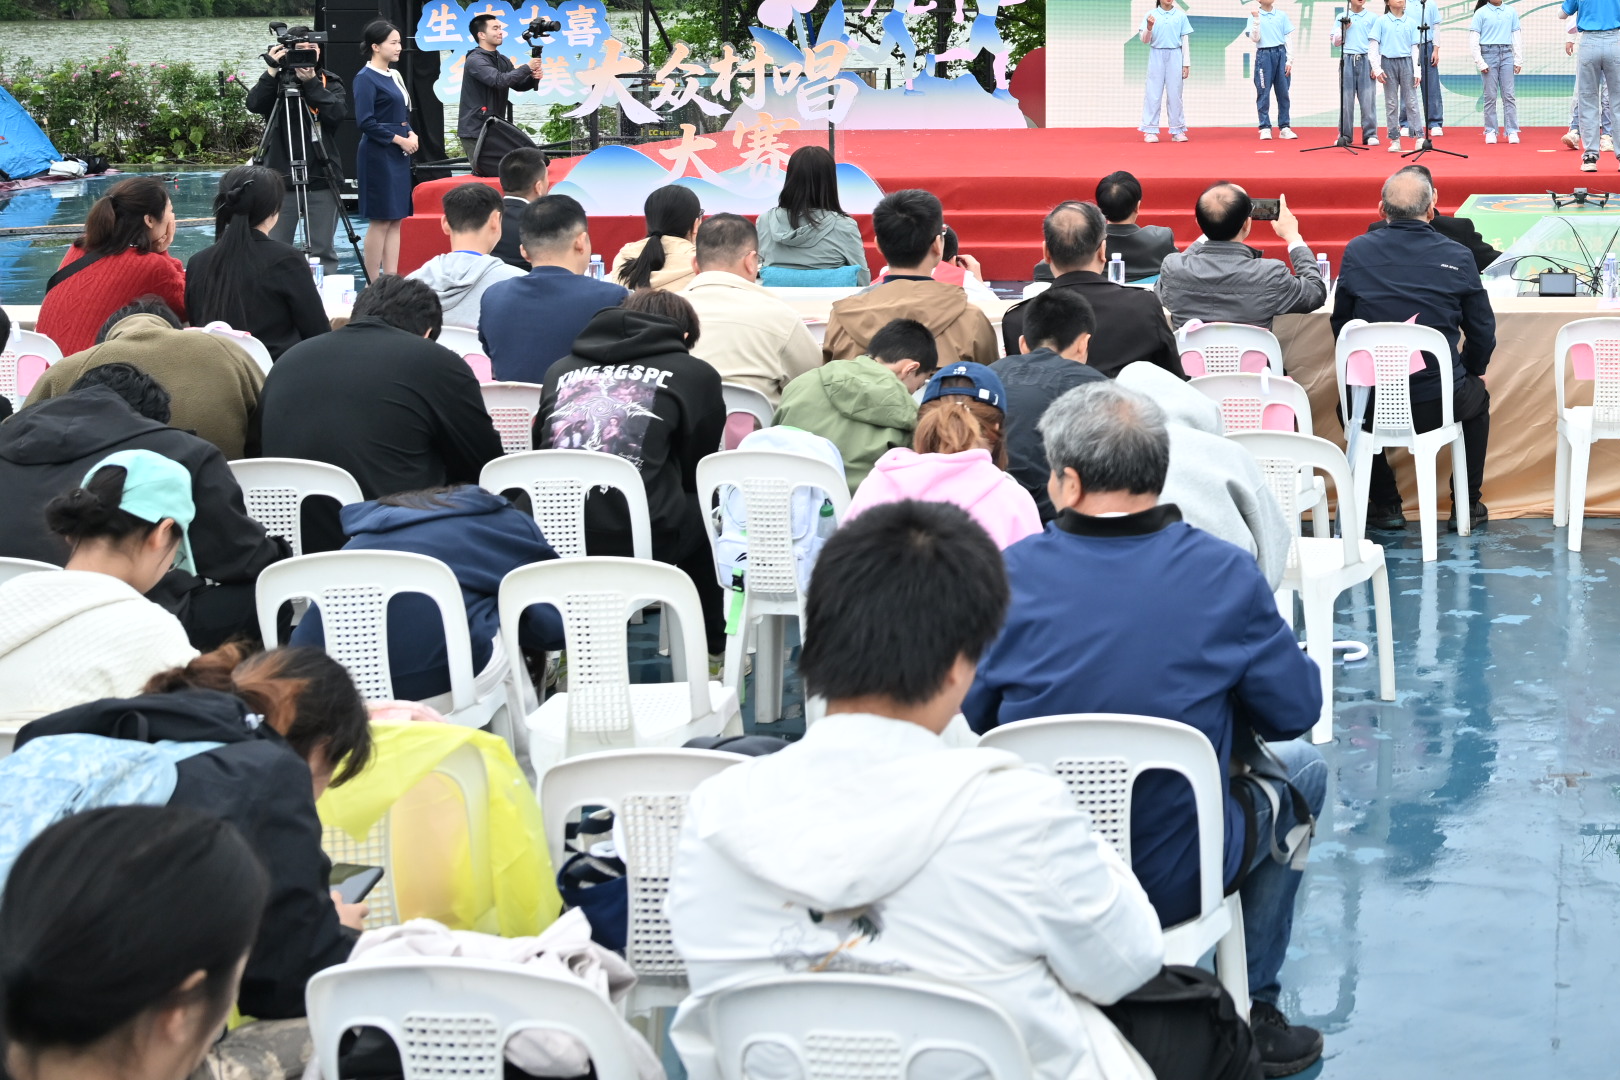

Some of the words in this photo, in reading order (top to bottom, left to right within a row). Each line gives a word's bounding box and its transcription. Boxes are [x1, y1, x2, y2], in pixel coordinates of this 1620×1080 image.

[562, 39, 859, 123] 大众村唱
[654, 111, 800, 186] 大赛
